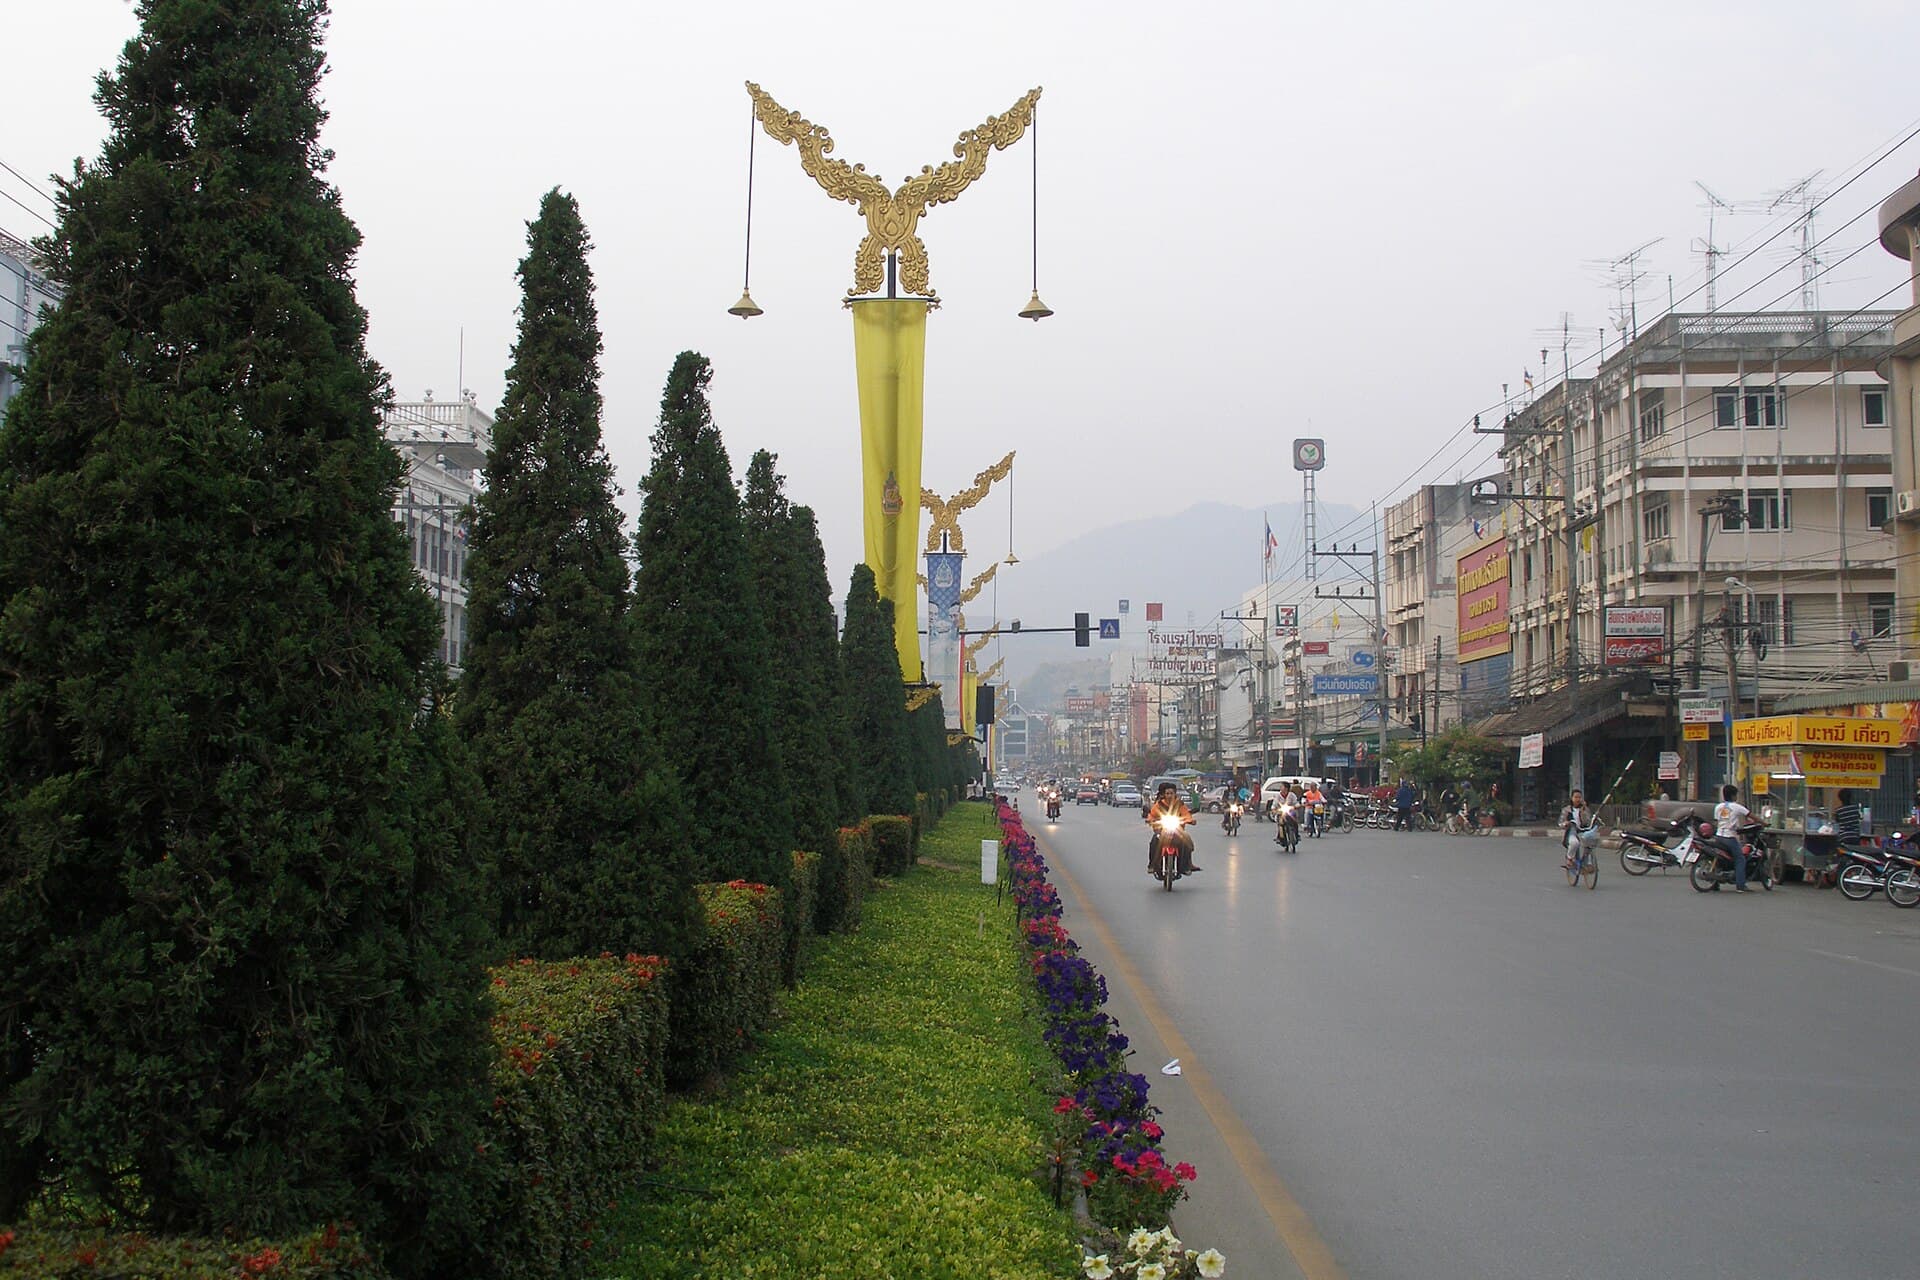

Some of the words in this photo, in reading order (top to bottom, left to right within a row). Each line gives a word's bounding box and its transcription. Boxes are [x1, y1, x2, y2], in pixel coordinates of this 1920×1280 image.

[1806, 722, 1845, 741] บะหมี่
[1853, 722, 1890, 743] เกี๊ยว
